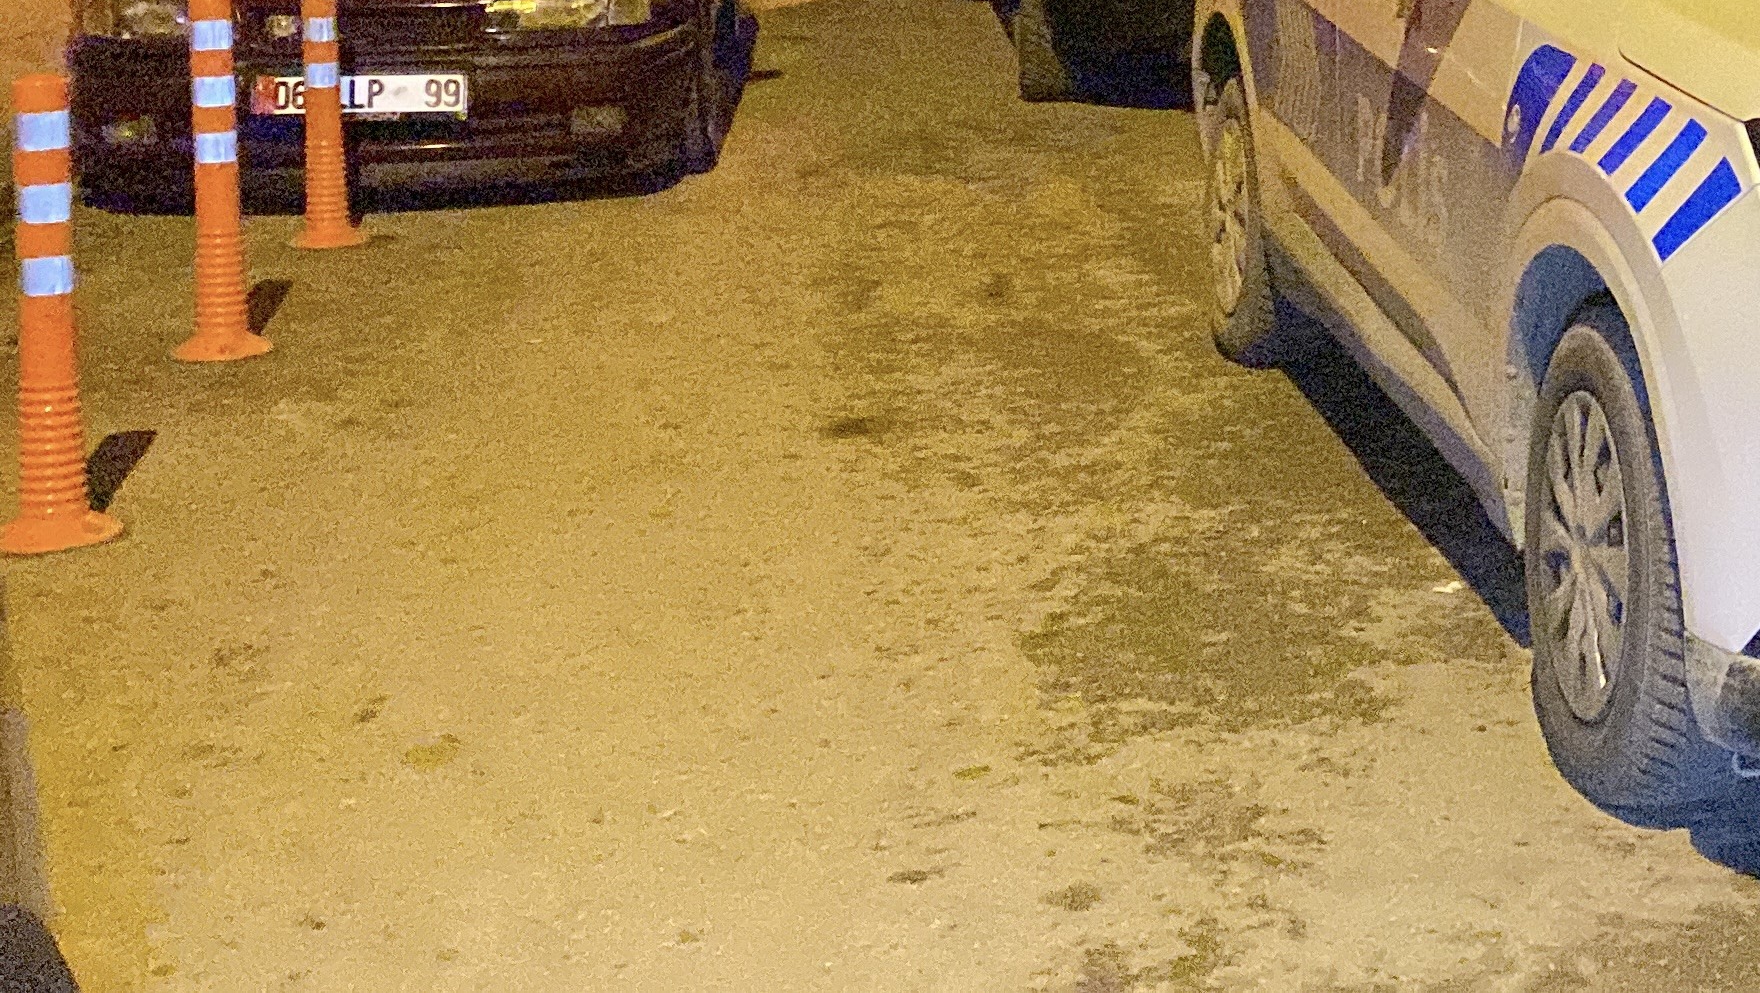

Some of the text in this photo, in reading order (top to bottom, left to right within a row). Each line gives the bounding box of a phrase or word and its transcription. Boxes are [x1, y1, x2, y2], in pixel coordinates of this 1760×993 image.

[275, 78, 462, 110] 06 LP 99
